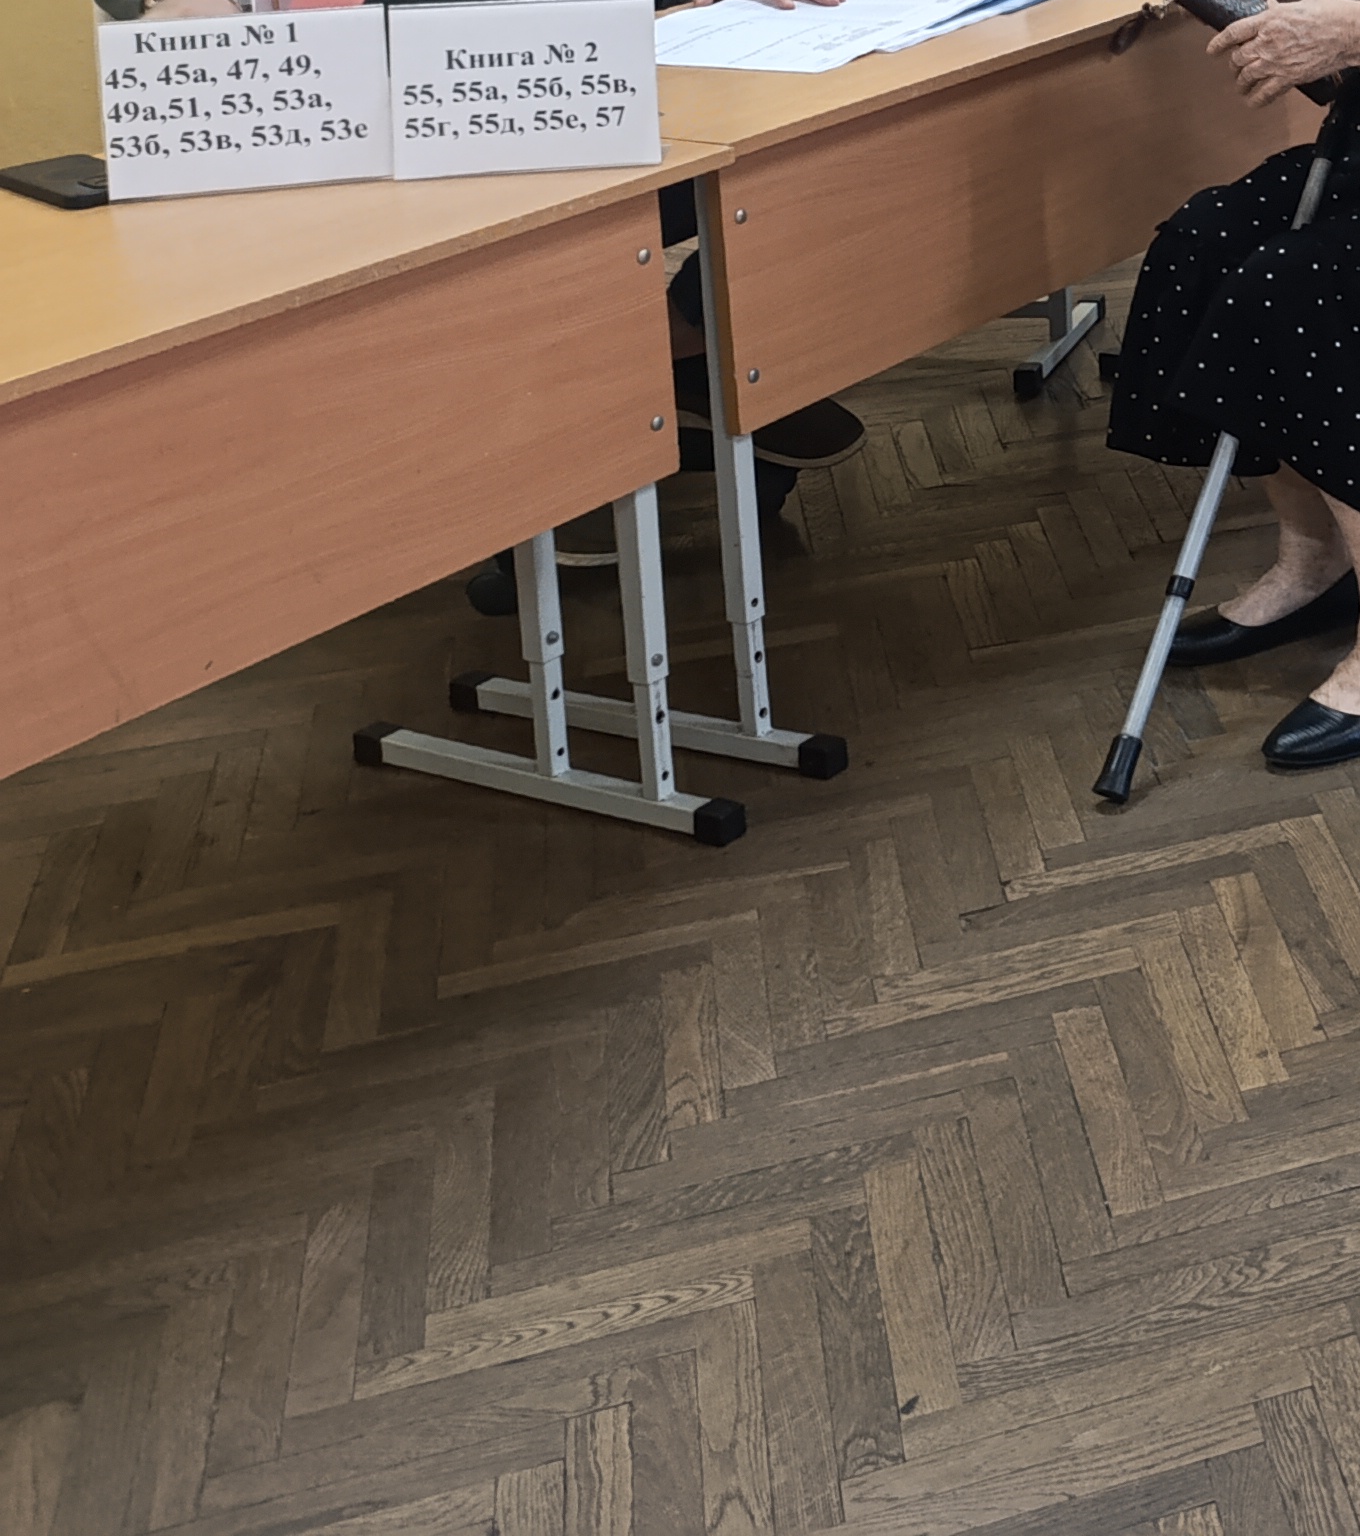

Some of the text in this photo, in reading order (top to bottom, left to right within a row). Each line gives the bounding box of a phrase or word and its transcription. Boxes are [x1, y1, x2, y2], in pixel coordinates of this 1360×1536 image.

[134, 22, 299, 54] Книга № 1
[445, 42, 599, 70] Книга № 2
[105, 54, 322, 92] 45, 45а, 47, 49,
[220, 93, 264, 116] 53,
[272, 89, 333, 112] 53а,
[403, 74, 637, 107] 55, 55а, 55б, 55в,
[109, 118, 369, 159] 53б, 53в, 53д, 53е
[404, 105, 626, 139] 55г, 55д, 55е, 57
